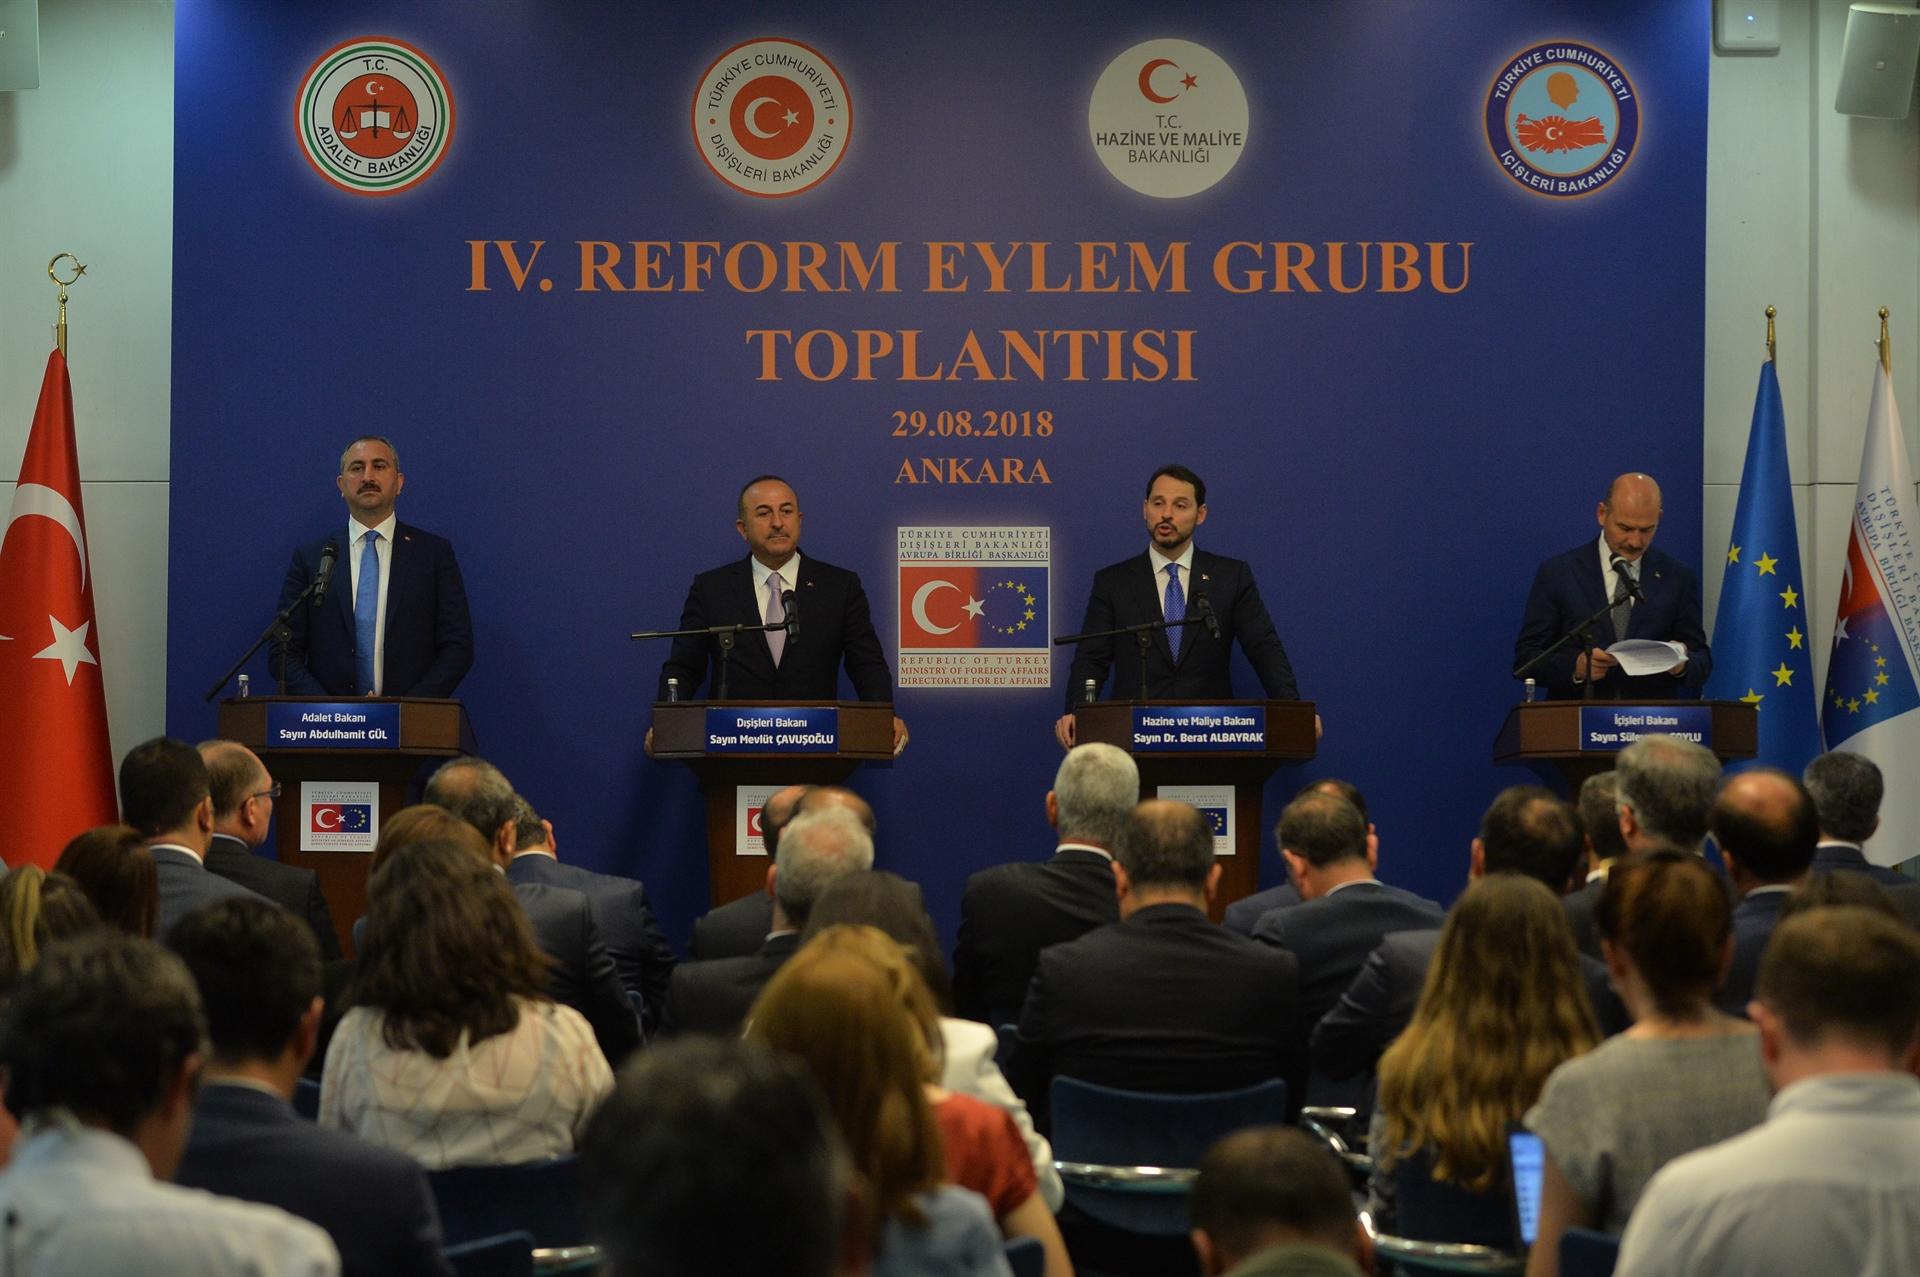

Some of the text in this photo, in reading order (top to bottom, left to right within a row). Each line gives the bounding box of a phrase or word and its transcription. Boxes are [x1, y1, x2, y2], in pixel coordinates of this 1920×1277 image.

[363, 59, 388, 71] T.C.
[1495, 49, 1631, 100] TÜRKİYE CUMHURİYETİ
[708, 53, 838, 110] TÜRKİYE CUMHURİYETİ
[1155, 115, 1181, 128] T.C.
[1096, 130, 1241, 146] HAZİNE VE MALİYE
[319, 125, 432, 173] ADALET BAKANLIĞI
[1128, 148, 1209, 163] BAKANLIĞI
[711, 133, 833, 182] DIŞİŞLERİ BAKANLIĞI
[1500, 148, 1626, 192] İÇİŞLERİ BAKANLIĞI
[465, 239, 1475, 294] IV. REFORM EYLEM GRUBU
[745, 329, 1198, 382] TOPLANTISI
[891, 410, 1054, 437] 29.08.2018
[893, 457, 1053, 484] ANKARA
[900, 530, 1049, 539] TÜRKİYE CUMHURİYETİ
[900, 540, 1049, 549] DIŞİŞLERİ BAKANLIĞI
[900, 550, 1049, 560] AVRUPA BİRLİĞİ BAŞKANLIĞI
[900, 657, 1049, 665] REPUBLIC OF TURKEY
[900, 667, 1049, 675] MINISTRY OF FOREIGN AFFAIRS
[900, 677, 1049, 685] DIRECTORATE FOR EU AFFAIRS
[301, 712, 366, 723] Adalet Bakanı
[737, 717, 807, 729] Dışişleri Bakanı
[1142, 716, 1255, 728] Hazine ve Maliye Bakanı
[1614, 713, 1678, 726] İçişleri Bakanı
[280, 728, 387, 741] Sayın Abdulhamit GÜL
[710, 732, 834, 746] Sayın Mevlüt ÇAVUŞOĞLU
[1134, 732, 1264, 745] Sayın Dr. Berat ALBAYRAK
[1590, 732, 1618, 744] Sayın
